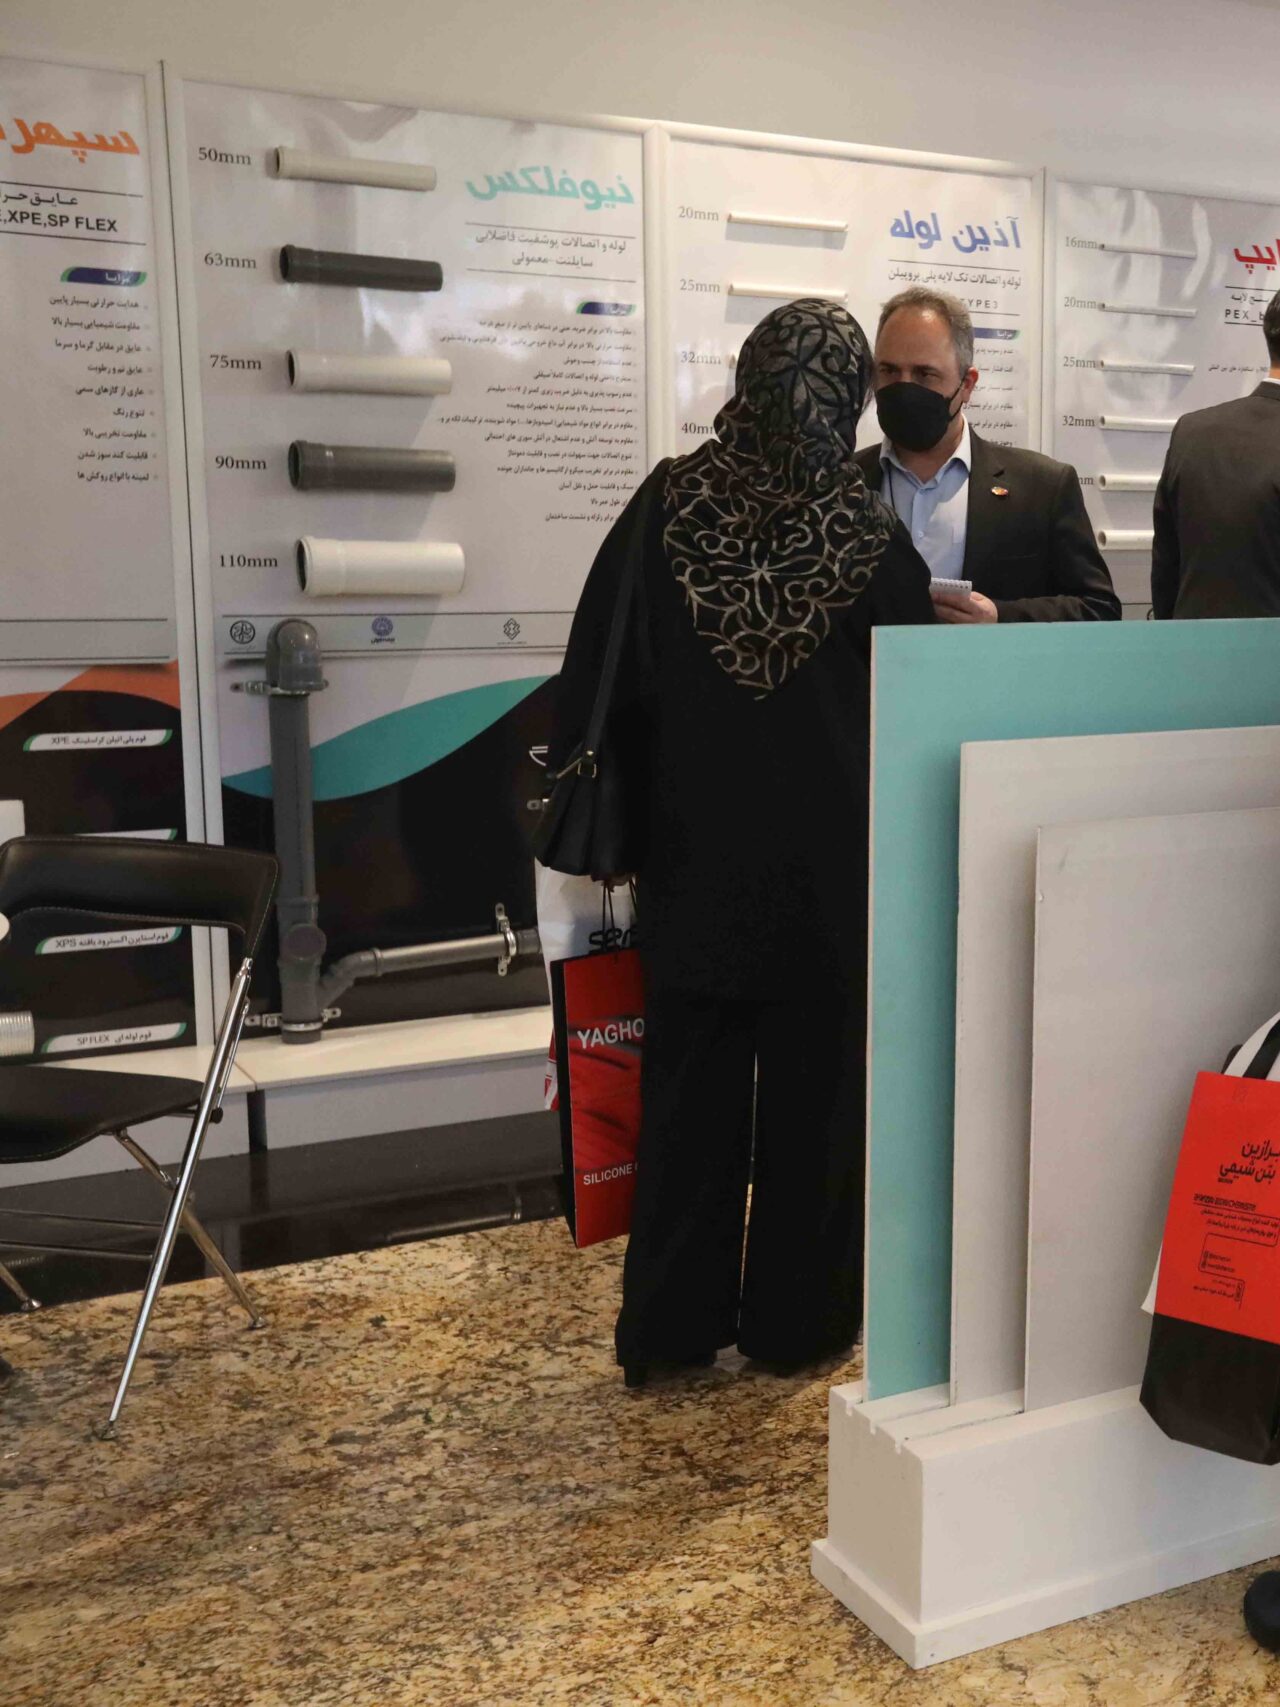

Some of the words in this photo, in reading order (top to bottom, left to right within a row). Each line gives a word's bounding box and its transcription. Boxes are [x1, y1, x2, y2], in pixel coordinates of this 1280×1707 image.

[198, 146, 252, 166] 50mm
[465, 164, 636, 212] نیوفلکس
[30, 192, 79, 207] عایق
[678, 205, 719, 221] 20mm
[75, 216, 118, 232] FLEX
[889, 209, 942, 250] لوله
[951, 216, 1022, 254] آذین
[1065, 236, 1098, 249] 16mm
[609, 240, 627, 255] لوله
[204, 251, 258, 270] 63mm
[680, 278, 720, 293] 25mm
[960, 298, 999, 309] YPE3
[1064, 296, 1098, 309] 20mm
[210, 354, 263, 371] 75mm
[681, 351, 721, 364] 32mm
[1063, 356, 1096, 369] 25mm
[1062, 415, 1095, 427] 32mm
[215, 455, 268, 471] 90mm
[219, 553, 279, 569] 110mm
[56, 938, 77, 949] XPS
[577, 1018, 645, 1050] YAGHO
[583, 1163, 633, 1185] SILICONE
